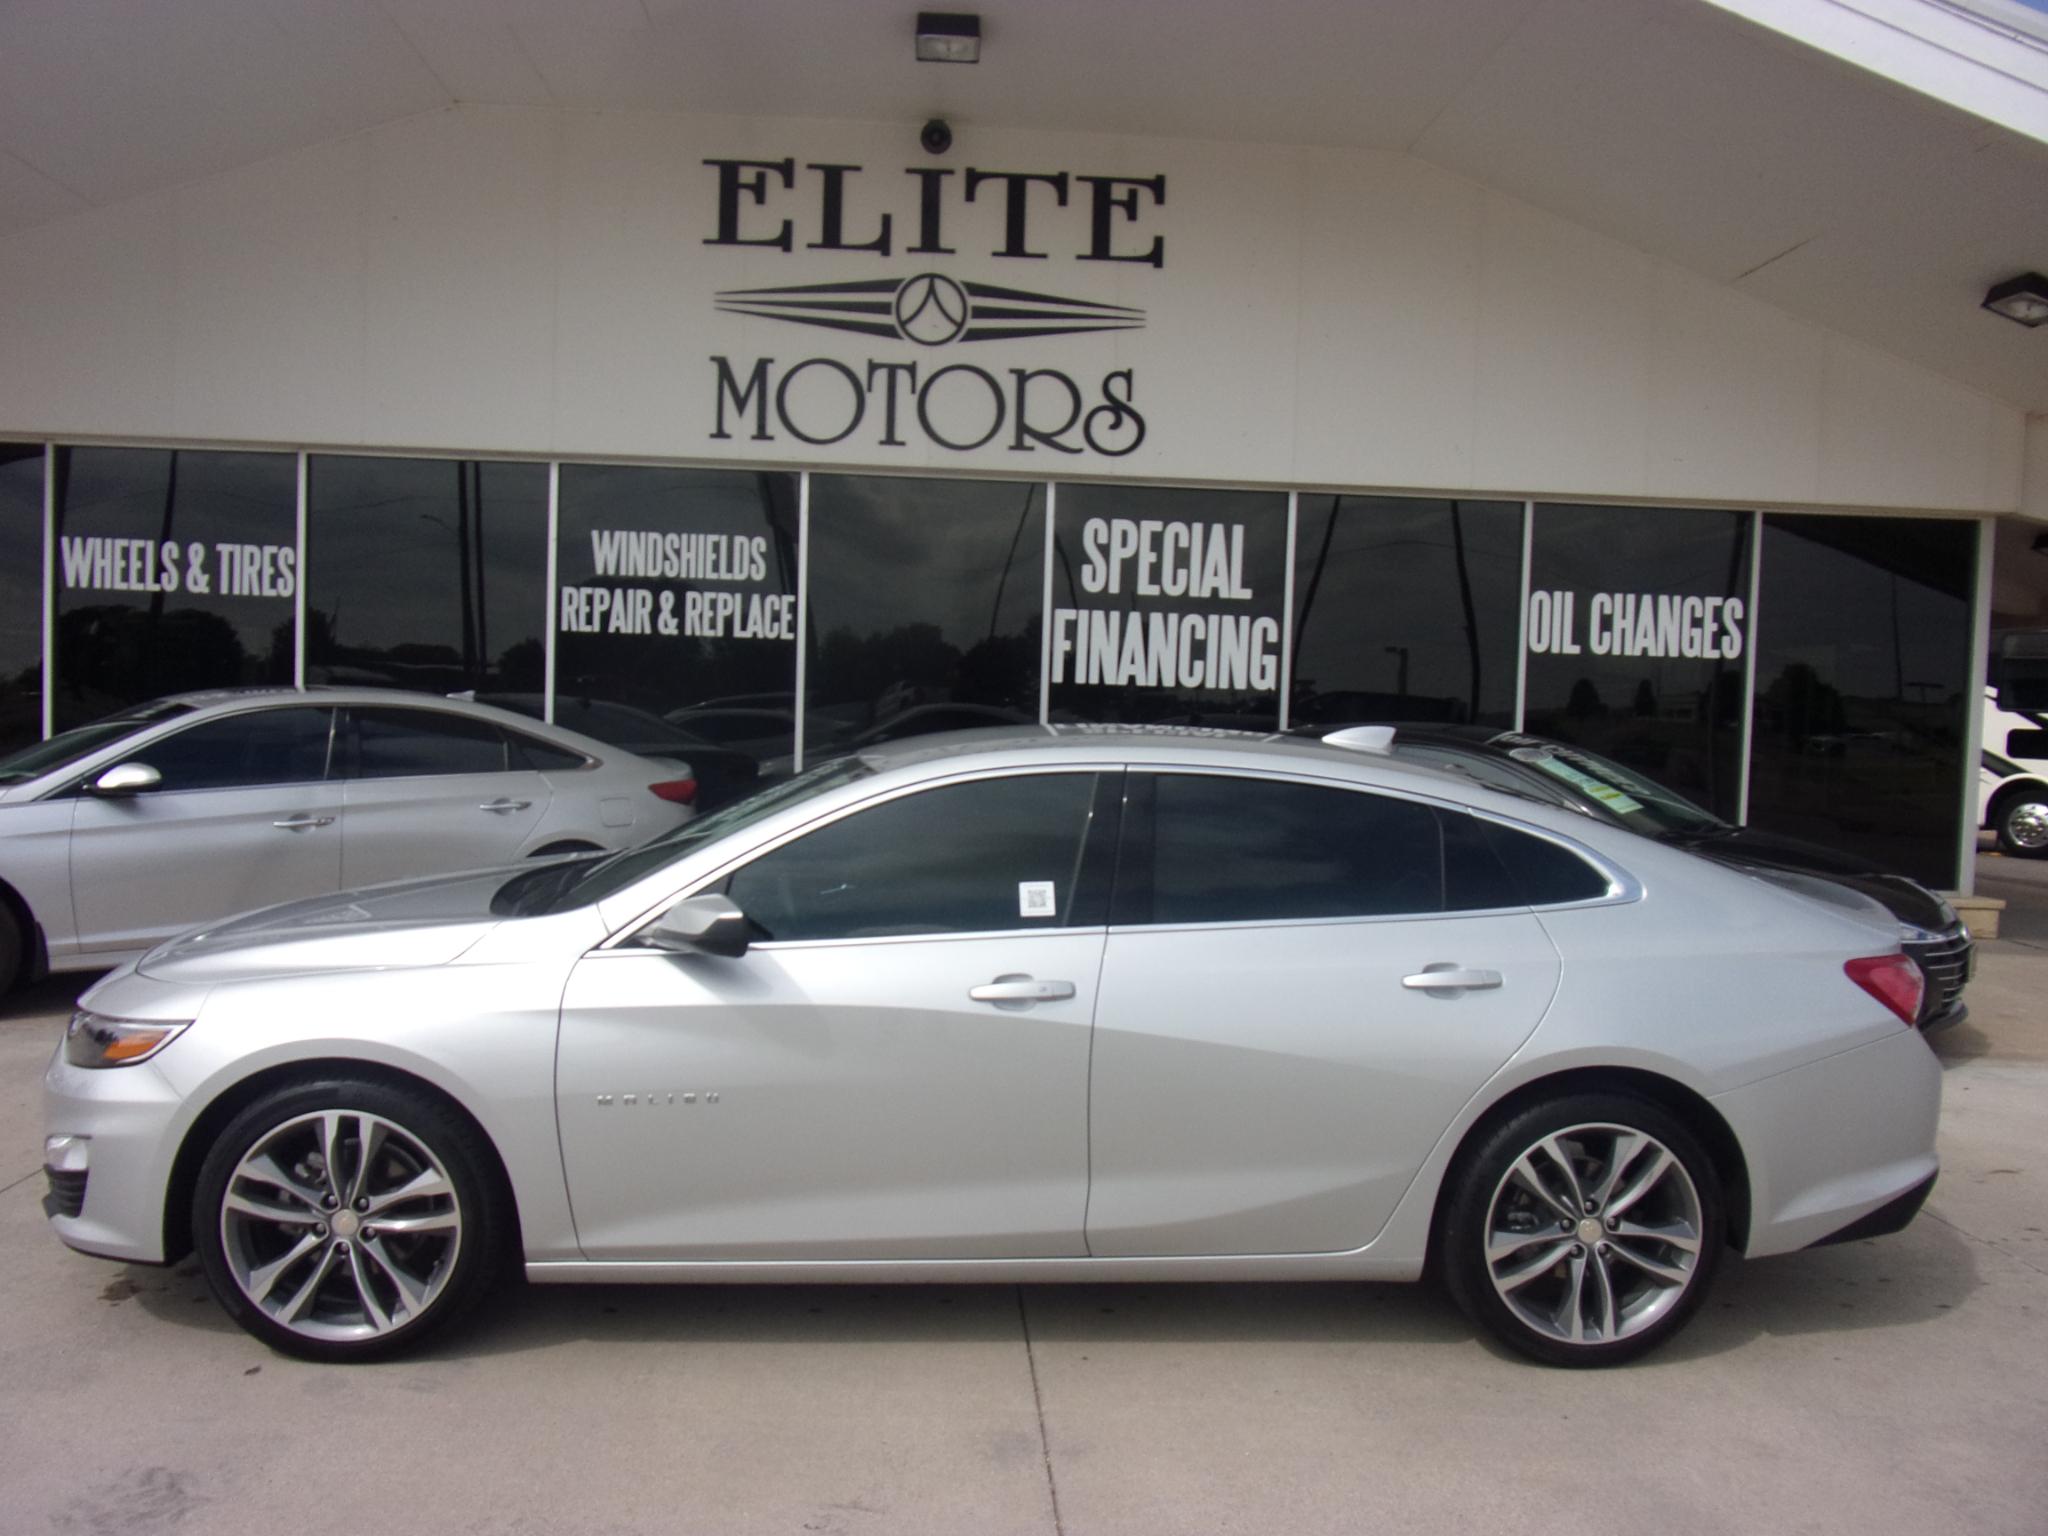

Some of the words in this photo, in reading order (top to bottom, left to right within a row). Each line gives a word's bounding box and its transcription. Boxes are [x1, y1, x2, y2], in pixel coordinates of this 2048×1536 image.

[702, 157, 1166, 269] ELITE
[709, 356, 1146, 457] MOTORS
[61, 536, 180, 592] WHEELS
[187, 542, 210, 595] &
[216, 543, 297, 599] TIRES
[590, 529, 767, 582] WINDSHIELDS
[1081, 517, 1253, 600] SPECIAL
[561, 586, 653, 635] REPAIR
[658, 590, 679, 636] &
[684, 590, 797, 641] REPLACE
[1051, 608, 1279, 691] FINANCING
[1528, 590, 1581, 655] OIL
[1589, 592, 1744, 660] CHANGES
